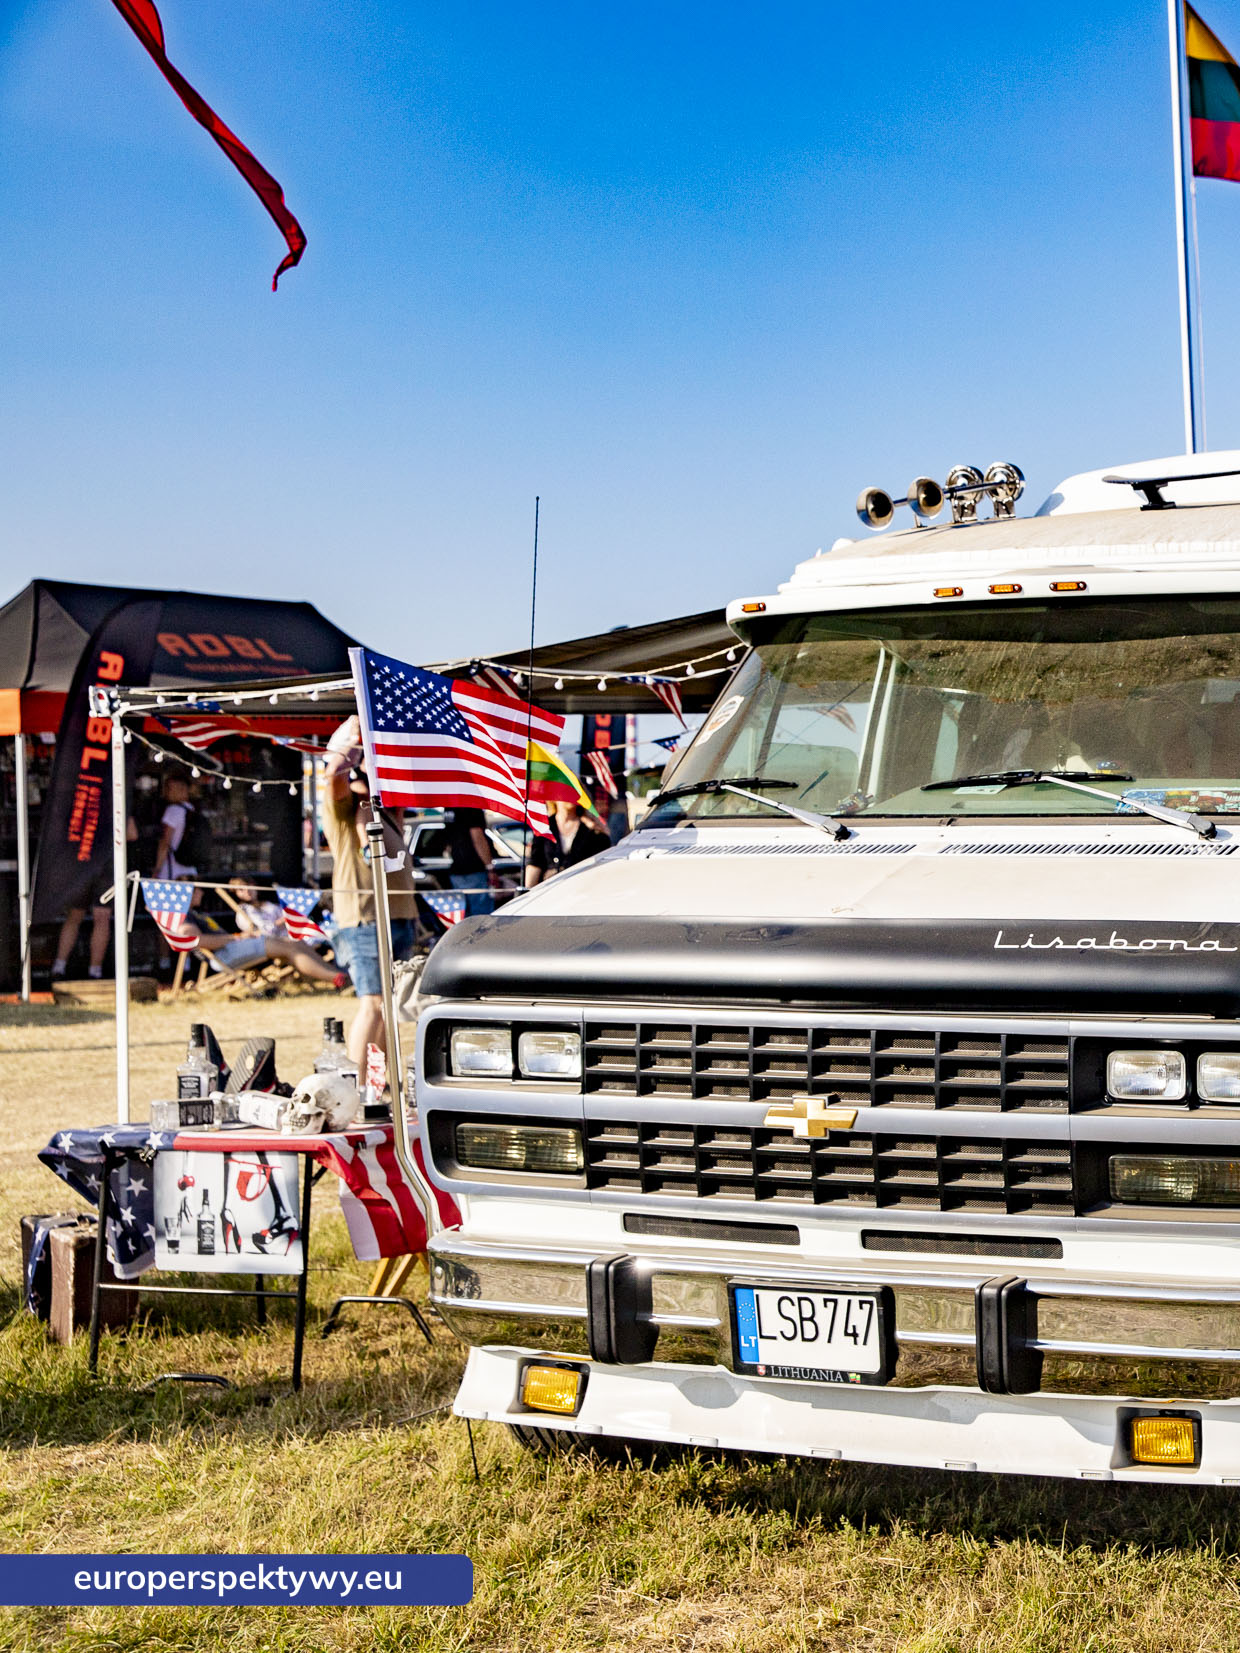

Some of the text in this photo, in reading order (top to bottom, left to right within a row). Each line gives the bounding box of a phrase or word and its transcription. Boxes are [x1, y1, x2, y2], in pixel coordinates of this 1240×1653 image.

[156, 633, 294, 662] ADBL
[80, 650, 125, 770] ABL
[993, 930, 1238, 952] Lisabona
[755, 1293, 874, 1346] LSB747
[740, 1335, 757, 1348] LT
[770, 1365, 844, 1383] LITHUANIA
